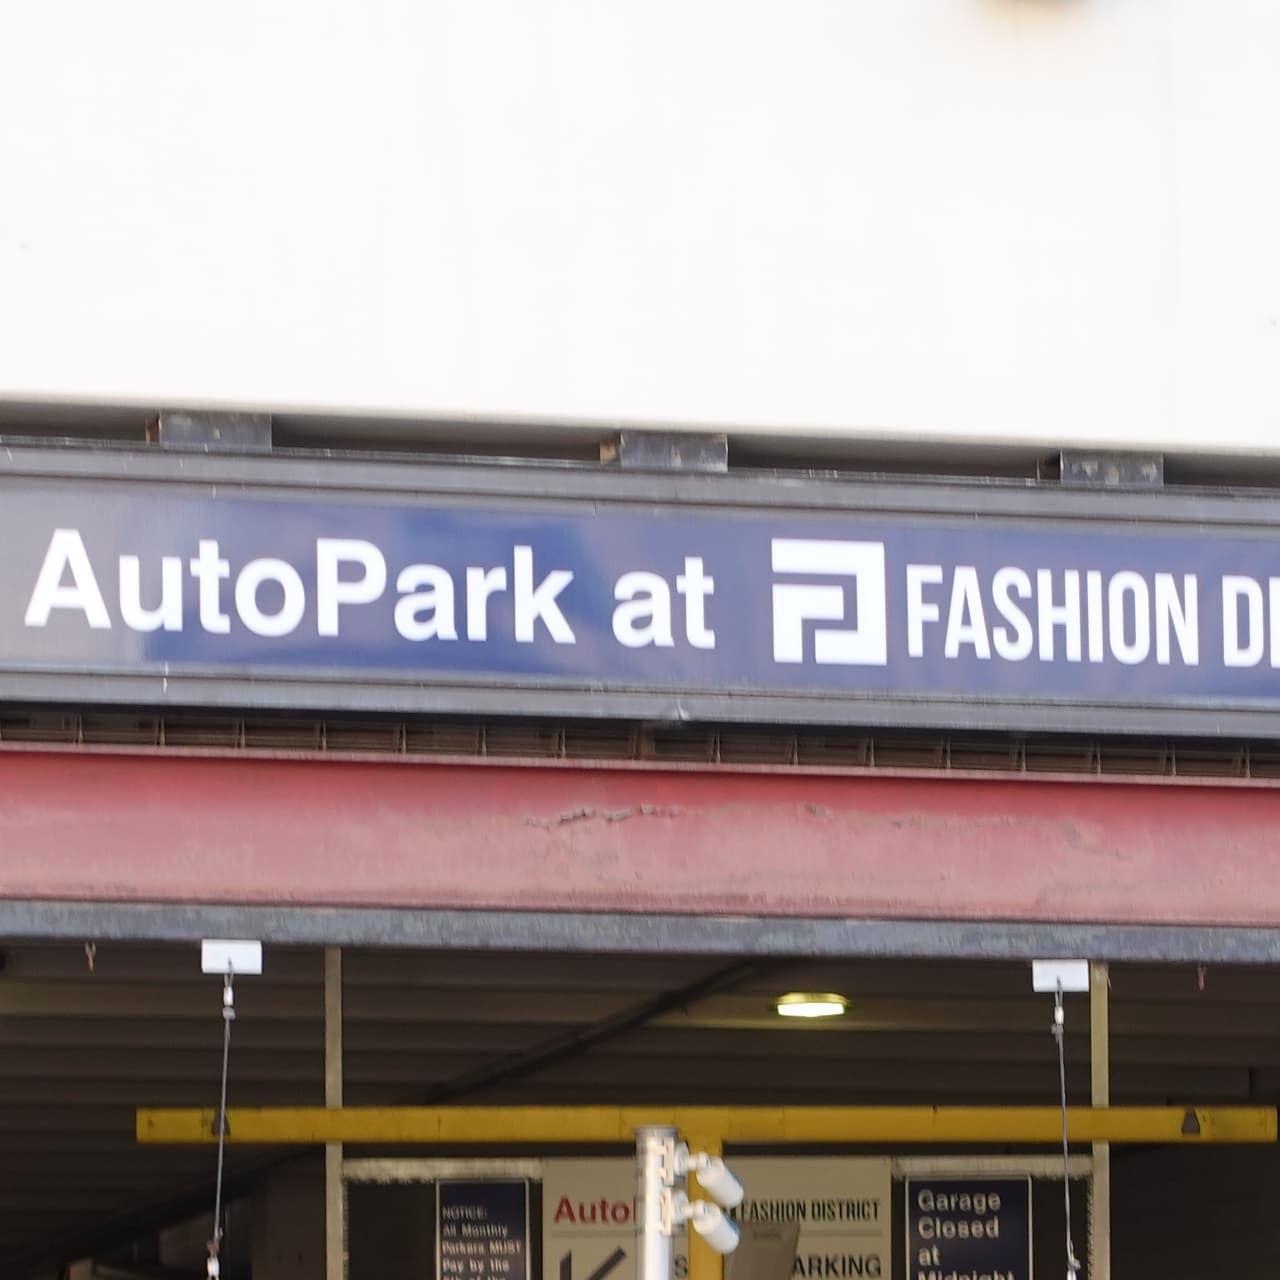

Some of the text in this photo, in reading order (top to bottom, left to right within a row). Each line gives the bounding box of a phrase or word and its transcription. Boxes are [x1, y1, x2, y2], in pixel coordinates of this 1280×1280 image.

[25, 529, 576, 644] AutoPark
[612, 555, 716, 649] at
[906, 564, 1200, 665] FASHION
[442, 1206, 487, 1219] NOTICE:
[554, 1195, 881, 1224] Auto FASHION DISTRICT
[917, 1189, 1001, 1215] Garage
[443, 1223, 508, 1238] All Monthly
[918, 1216, 1000, 1239] Closed
[442, 1240, 521, 1255] Parkers MUST
[918, 1244, 940, 1266] at
[442, 1259, 510, 1274] Pay by the
[792, 1255, 882, 1279] ARKING
